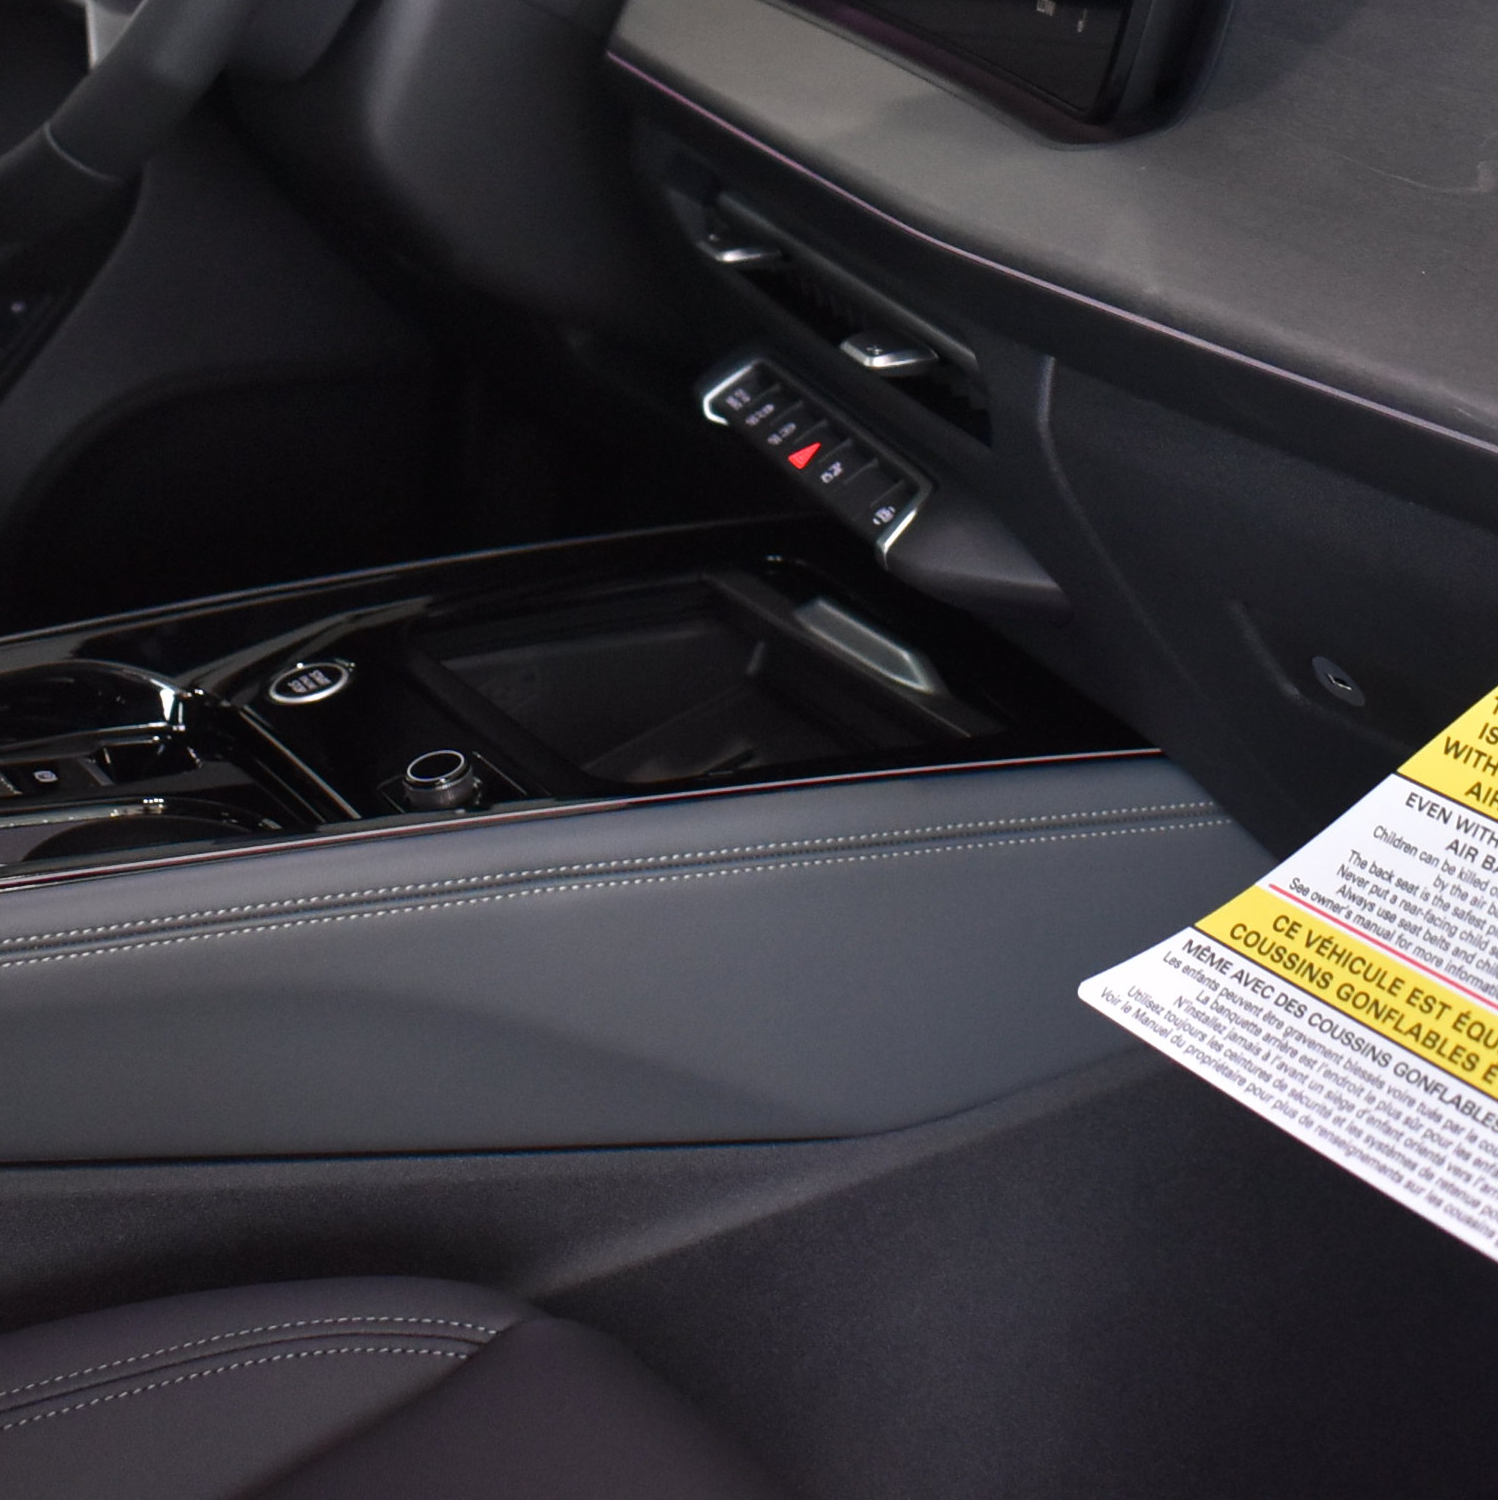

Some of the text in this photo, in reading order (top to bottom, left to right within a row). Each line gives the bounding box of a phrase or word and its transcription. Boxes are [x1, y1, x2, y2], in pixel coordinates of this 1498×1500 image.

[1405, 791, 1453, 825] EVEN
[1445, 838, 1479, 864] AIR
[1336, 863, 1371, 890] Never
[1367, 883, 1391, 901] put
[1389, 894, 1399, 905] a
[1398, 898, 1459, 939] rear-facing
[1458, 929, 1491, 952] child
[1348, 849, 1369, 870] The
[1368, 860, 1395, 884] back
[1394, 877, 1420, 897] seat
[1419, 886, 1431, 903] is
[1431, 894, 1452, 913] the
[1451, 906, 1488, 931] safest
[1372, 824, 1419, 857] Children
[1418, 850, 1441, 868] can
[1440, 858, 1457, 876] be
[1456, 866, 1491, 893] killed
[1432, 874, 1450, 893] by
[1449, 883, 1469, 902] the
[1469, 895, 1488, 910] air
[1272, 914, 1303, 941] CE
[1304, 929, 1406, 997] VÉHICULE
[1405, 986, 1453, 1021] EST
[1288, 877, 1311, 897] See
[1352, 913, 1397, 942] manual
[1394, 932, 1414, 951] for
[1411, 945, 1445, 968] more
[1335, 883, 1377, 913] Always
[1376, 906, 1398, 924] use
[1397, 917, 1423, 938] seat
[1422, 927, 1452, 952] belts
[1451, 946, 1478, 965] and
[1162, 950, 1183, 969] Les
[1181, 964, 1221, 992] enfants
[1216, 986, 1264, 1018] peuvent
[1261, 1010, 1285, 1030] être
[1282, 1025, 1345, 1066] gravement
[1342, 1057, 1386, 1091] blessés
[1386, 1084, 1417, 1109] voire
[1416, 1101, 1444, 1124] tués
[1441, 1118, 1466, 1136] par
[1465, 1128, 1479, 1144] le
[1181, 938, 1234, 976] MÊME
[1230, 968, 1276, 1000] AVEC
[1273, 992, 1308, 1019] DES
[1307, 1012, 1393, 1068] COUSSINS
[1229, 922, 1334, 990] COUSSINS
[1335, 982, 1481, 1073] GONFLABLES
[1100, 986, 1122, 1006] Voir
[1120, 1000, 1133, 1014] le
[1131, 1007, 1174, 1039] Manuel
[1169, 1034, 1187, 1049] du
[1182, 1044, 1247, 1087] propriétaire
[1243, 1082, 1275, 1103] pour
[1270, 1099, 1299, 1120] plus
[1297, 1114, 1315, 1129] de
[1313, 1124, 1405, 1185] renseignements
[1403, 1179, 1426, 1196] sur
[1424, 1189, 1444, 1208] les
[1442, 1203, 1497, 1240] coussins
[1127, 985, 1165, 1016] Utilisez
[1163, 1009, 1208, 1043] toujours
[1206, 1035, 1225, 1053] les
[1223, 1048, 1273, 1083] ceintures
[1272, 1077, 1289, 1093] de
[1287, 1087, 1334, 1120] sécurité
[1331, 1115, 1347, 1128] et
[1345, 1120, 1364, 1139] les
[1363, 1134, 1419, 1172] systèmes
[1417, 1166, 1436, 1182] de
[1435, 1177, 1482, 1209] retenue
[1195, 989, 1211, 1006] La
[1209, 997, 1263, 1037] banquette
[1261, 1032, 1299, 1059] arrière
[1298, 1054, 1319, 1071] est
[1363, 1089, 1377, 1105] le
[1373, 1100, 1404, 1122] plus
[1401, 1115, 1425, 1132] sûr
[1420, 1127, 1454, 1150] pour
[1452, 1142, 1473, 1162] les
[1223, 1027, 1263, 1057] jamais
[1261, 1050, 1271, 1062] à
[1307, 1079, 1325, 1095] un
[1323, 1089, 1356, 1114] siège
[1403, 1137, 1447, 1167] orienté
[1446, 1162, 1474, 1184] vers
